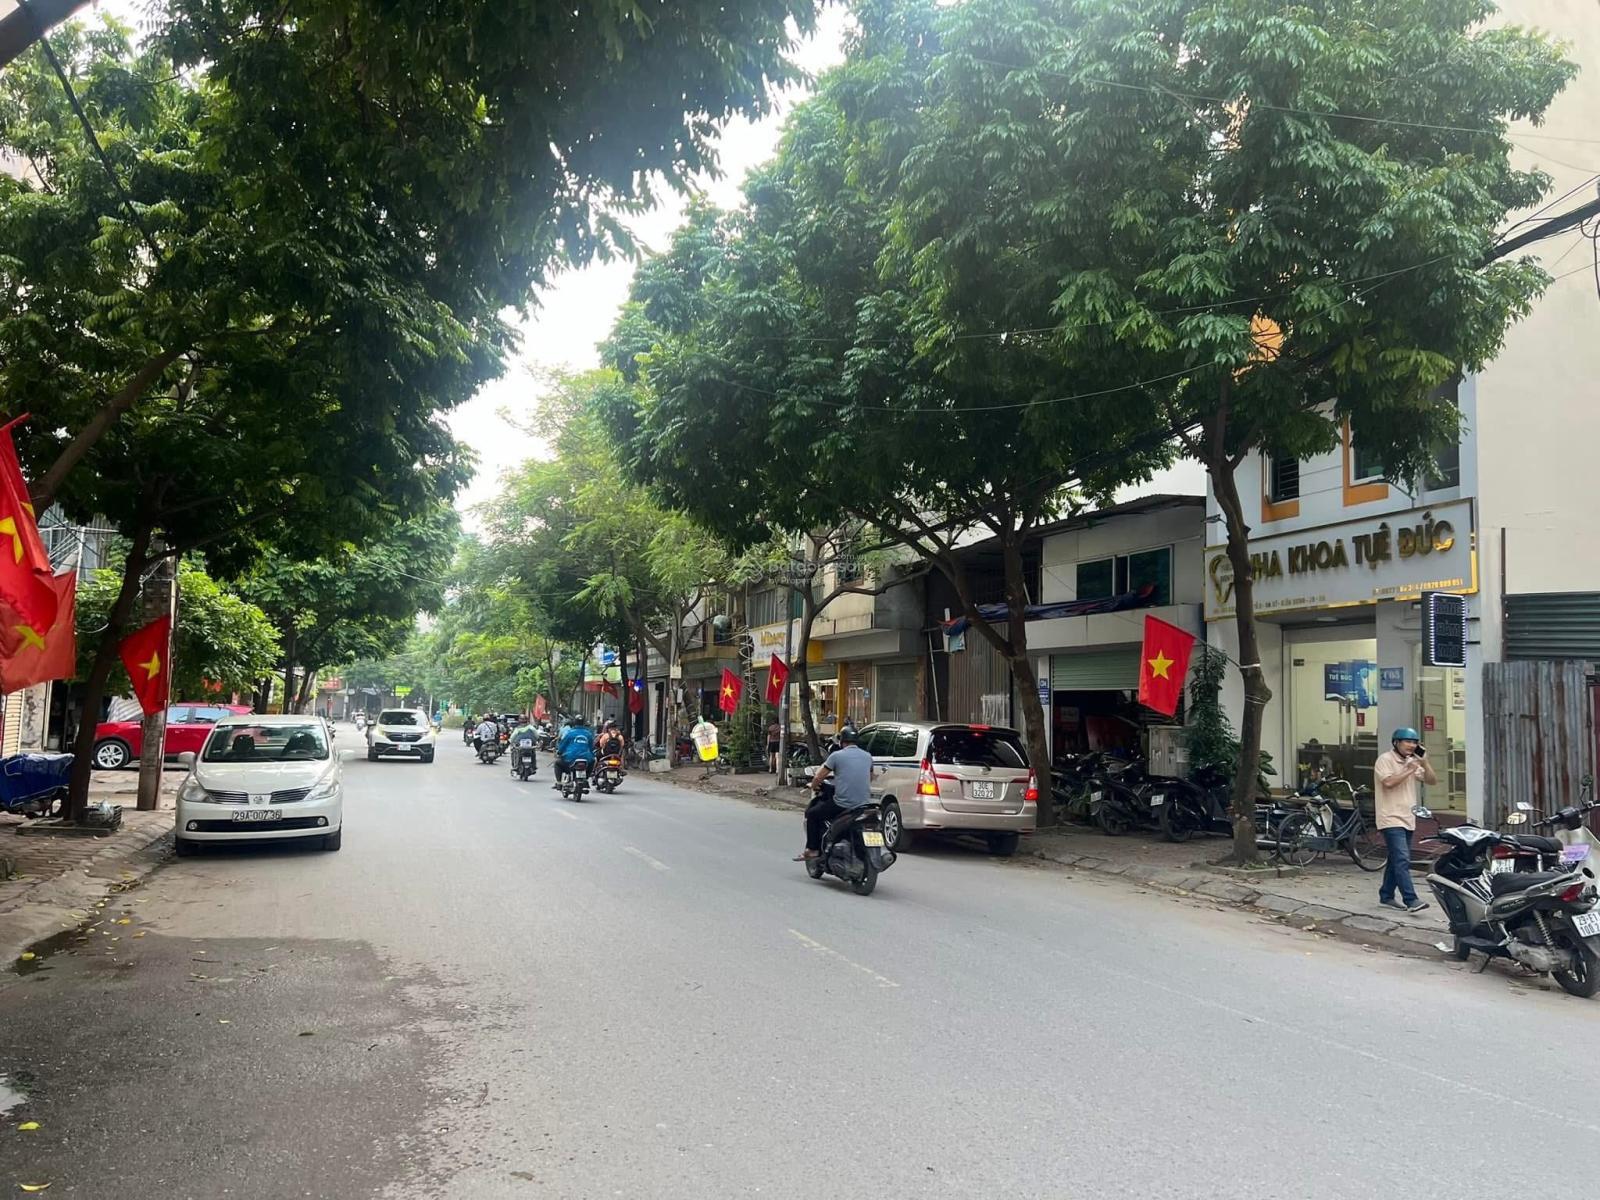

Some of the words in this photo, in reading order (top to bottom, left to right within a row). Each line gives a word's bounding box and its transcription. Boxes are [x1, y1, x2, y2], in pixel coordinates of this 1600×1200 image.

[1249, 549, 1284, 579] HA
[1288, 538, 1349, 574] KHOA
[1352, 522, 1392, 569] TUỆ
[1398, 510, 1456, 559] ĐỨC
